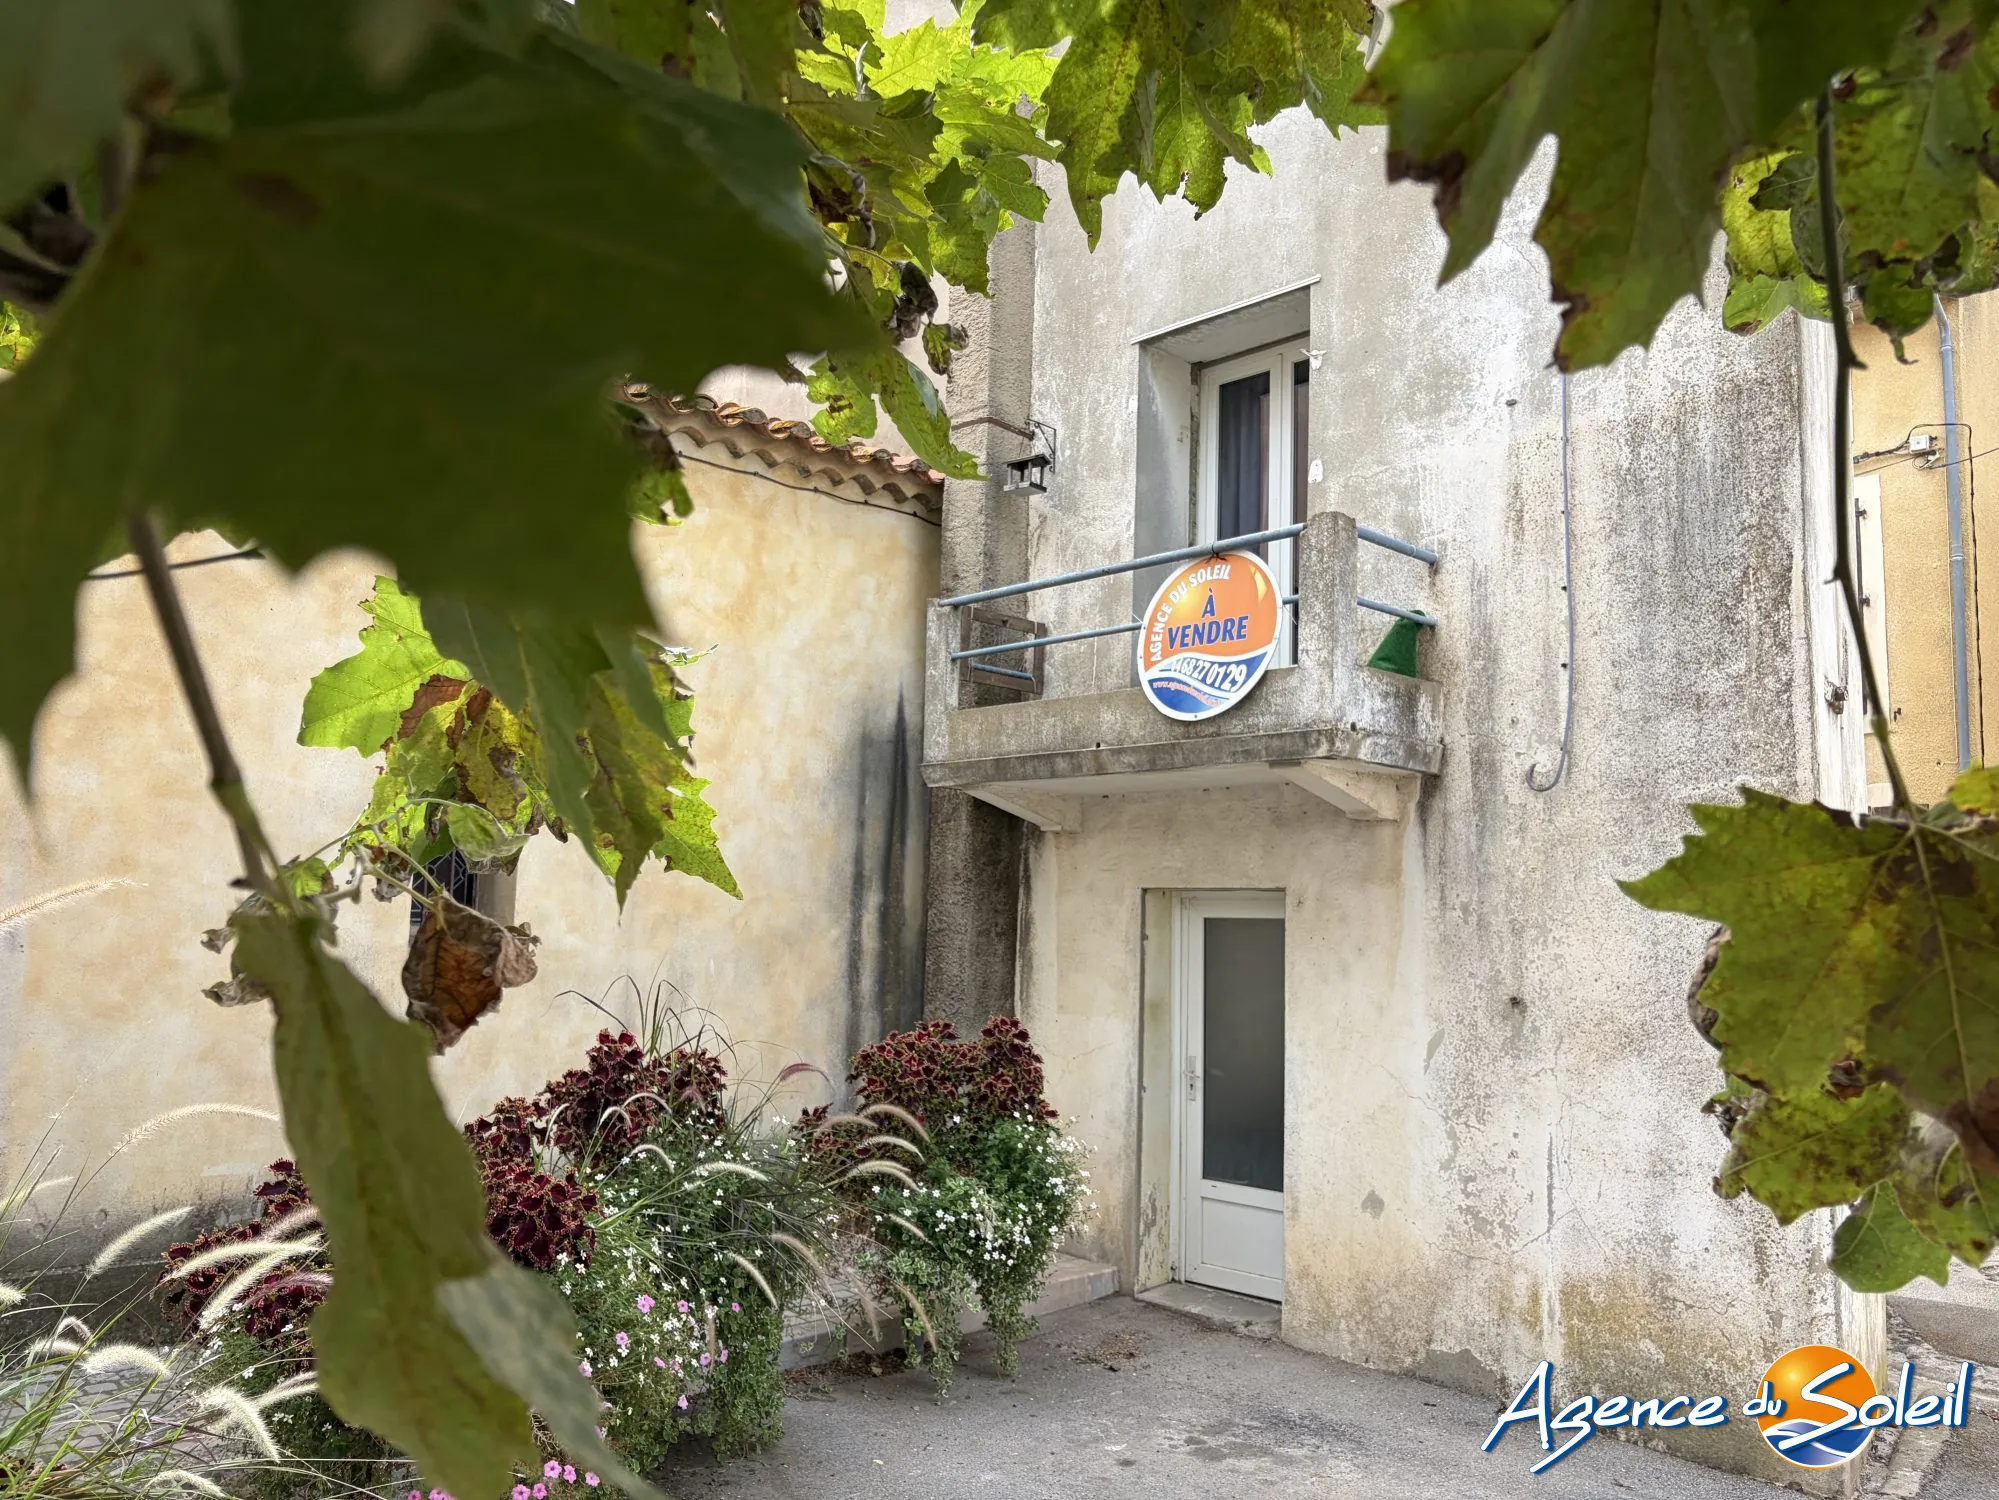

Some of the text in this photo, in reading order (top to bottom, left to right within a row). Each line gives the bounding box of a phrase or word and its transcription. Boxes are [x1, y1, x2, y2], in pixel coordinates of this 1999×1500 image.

[1150, 564, 1232, 662] AGENCE DU SOLEIL
[1201, 588, 1216, 619] À
[1167, 616, 1249, 650] VENDRE
